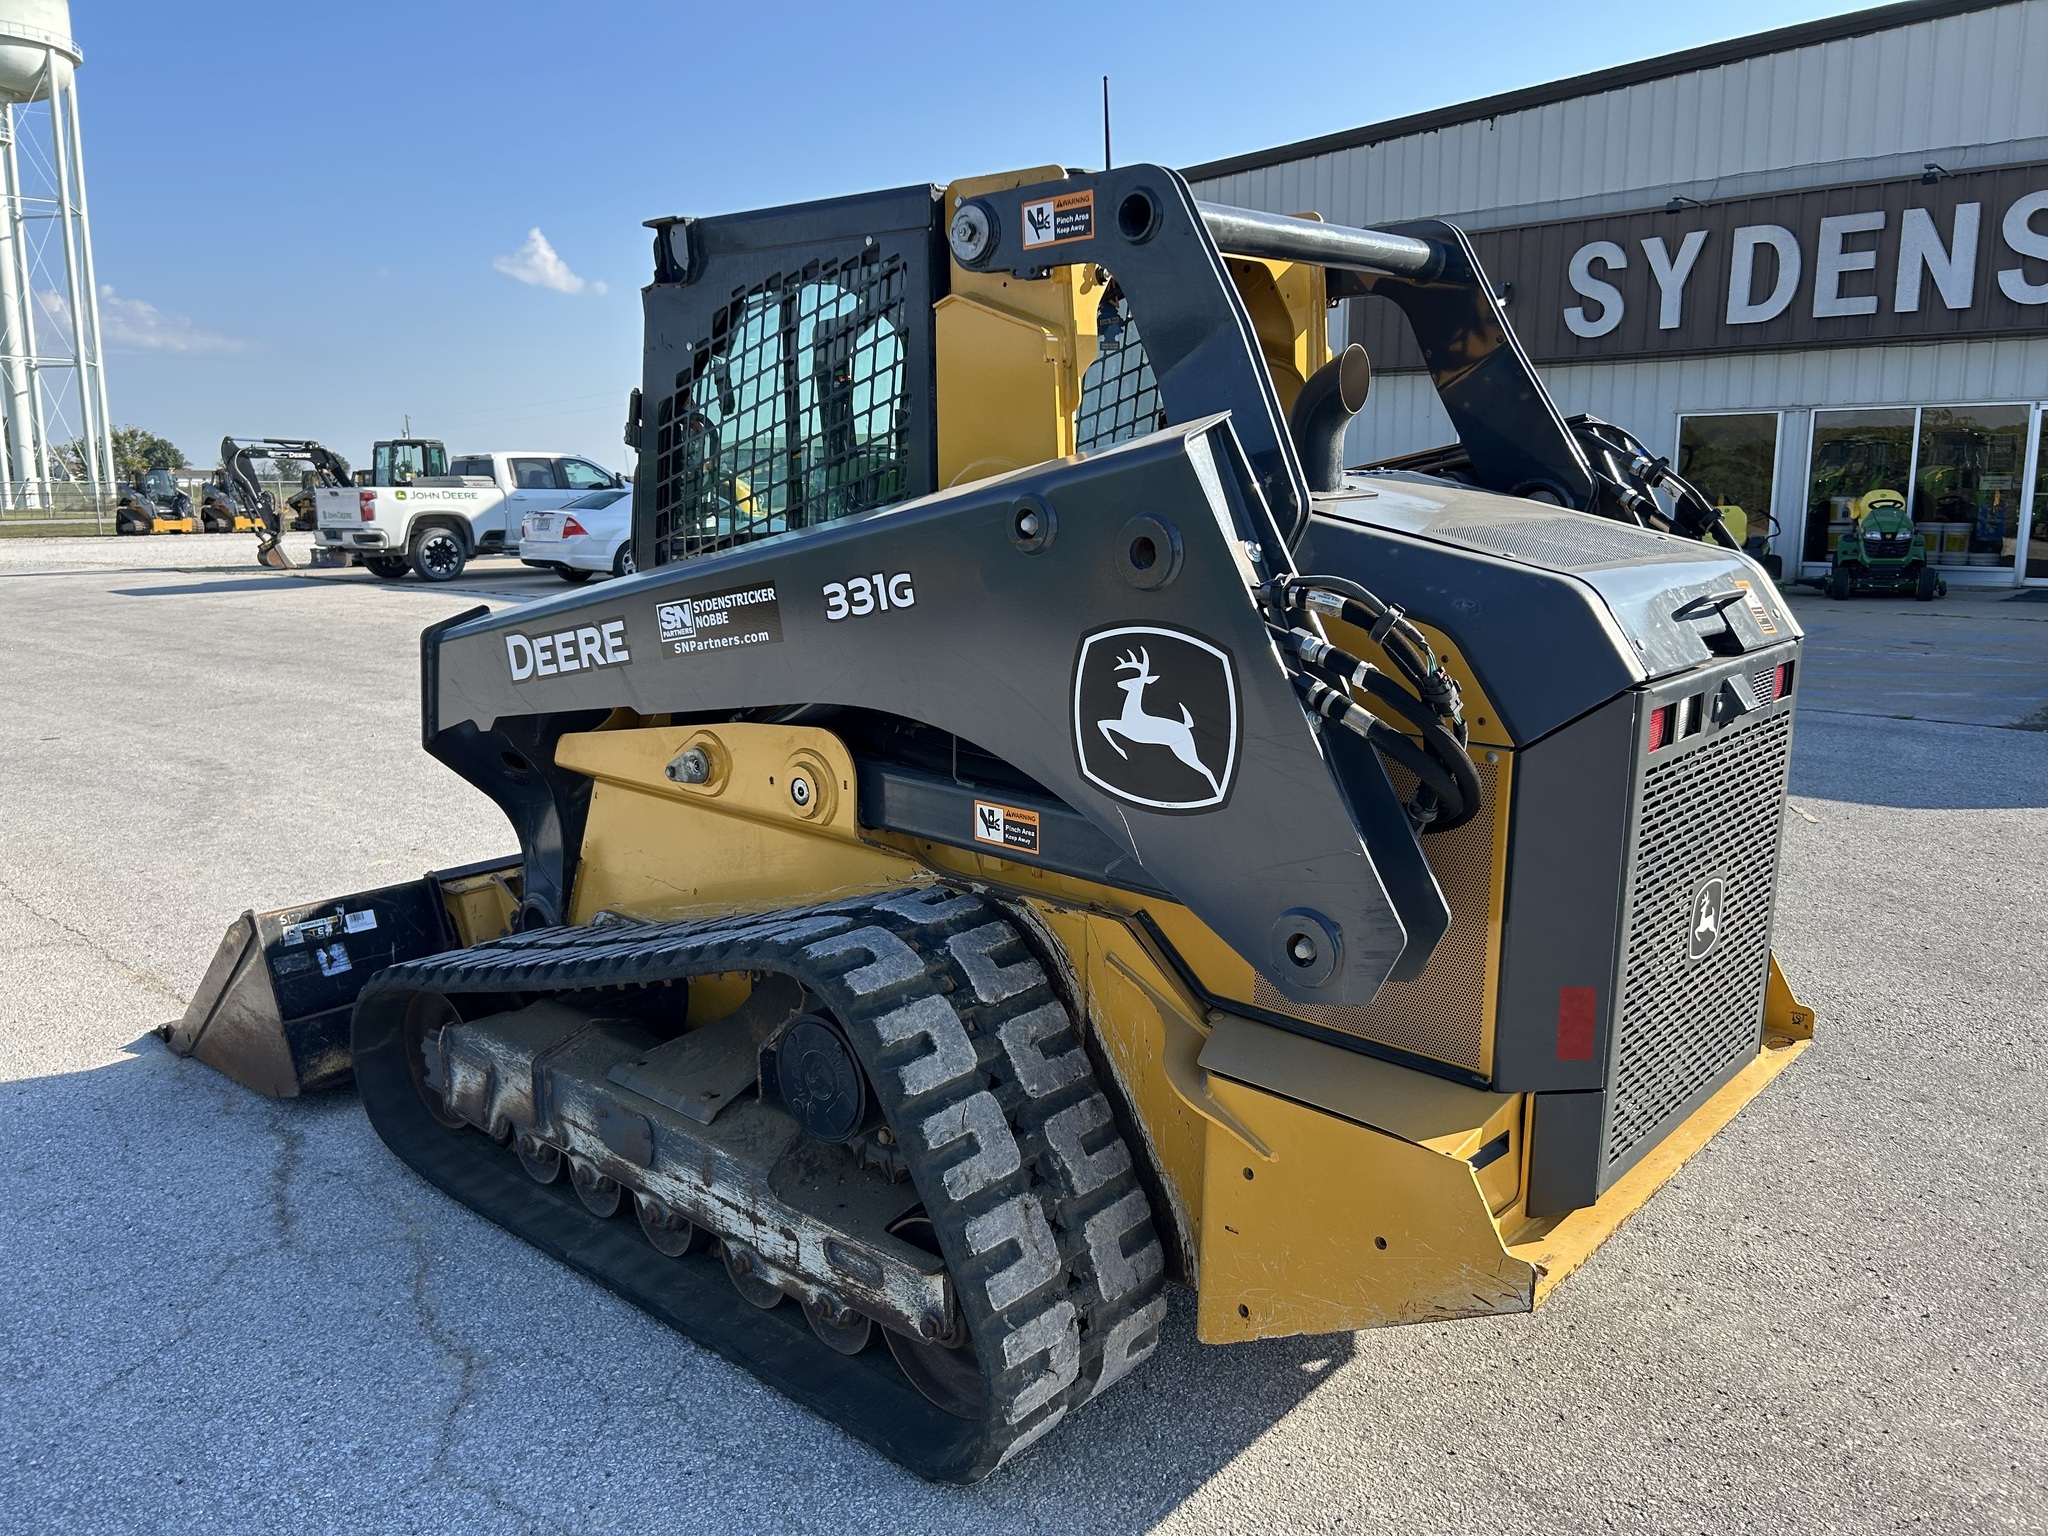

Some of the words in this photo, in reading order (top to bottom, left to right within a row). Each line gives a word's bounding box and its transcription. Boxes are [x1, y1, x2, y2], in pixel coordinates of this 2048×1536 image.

[1062, 195, 1090, 206] WARNING
[1056, 215, 1074, 225] Pinch
[1075, 213, 1089, 222] Area
[1056, 227, 1070, 235] Keep
[1071, 224, 1085, 232] Away
[1563, 189, 2048, 338] SYDENS
[410, 490, 440, 500] JOHN
[442, 490, 478, 500] DEERE
[693, 587, 777, 614] SYDENSTRICKER
[823, 573, 915, 620] 331G
[660, 603, 692, 630] SN
[695, 611, 729, 629] NOBBE
[663, 627, 694, 638] PARTNERS
[674, 631, 770, 654] SNPartners.com
[505, 620, 629, 681] DEERE
[1011, 811, 1036, 822] WARNING
[1005, 824, 1021, 834] Pinch
[1022, 828, 1035, 837] Area
[1005, 833, 1017, 842] Keep
[1018, 836, 1031, 845] Away
